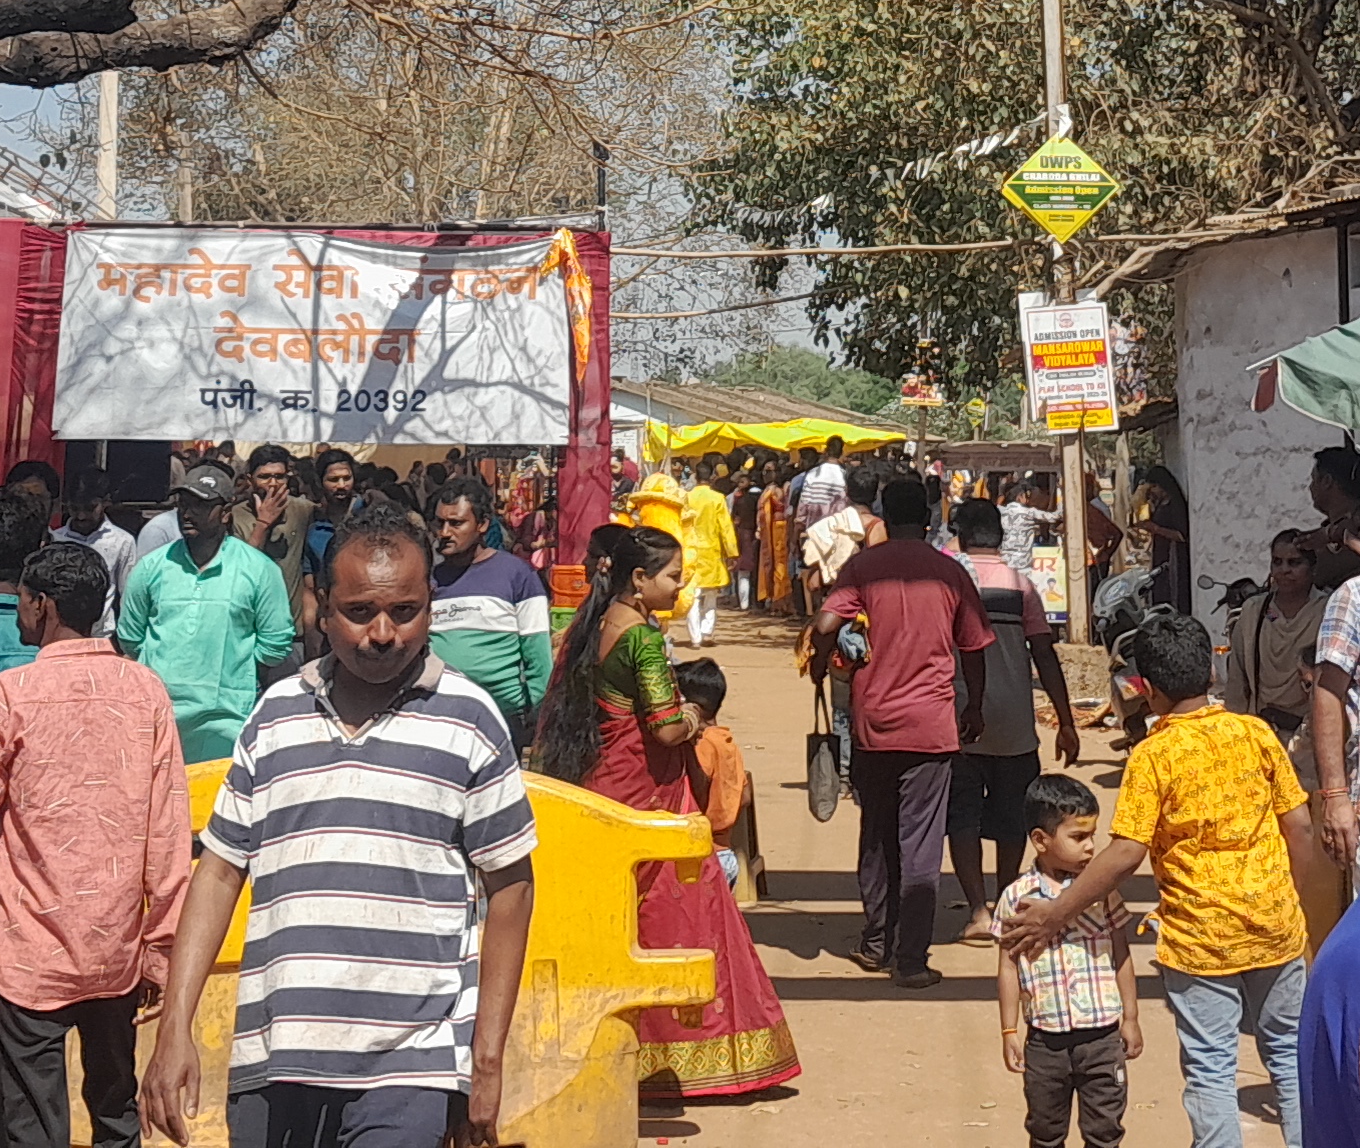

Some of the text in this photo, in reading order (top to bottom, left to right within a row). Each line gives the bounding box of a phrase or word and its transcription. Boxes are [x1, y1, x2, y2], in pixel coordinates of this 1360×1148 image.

[1039, 155, 1082, 170] DWPS
[97, 248, 251, 303] महादेव
[273, 249, 359, 299] सेवा
[213, 310, 421, 364] देवबलौदा
[1034, 328, 1101, 342] ADMISSION OPEN
[1032, 341, 1104, 356] MANSAROWAR
[1043, 353, 1096, 367] VIDYALAYA
[198, 378, 263, 412] पंजी.
[337, 389, 428, 413] 20392
